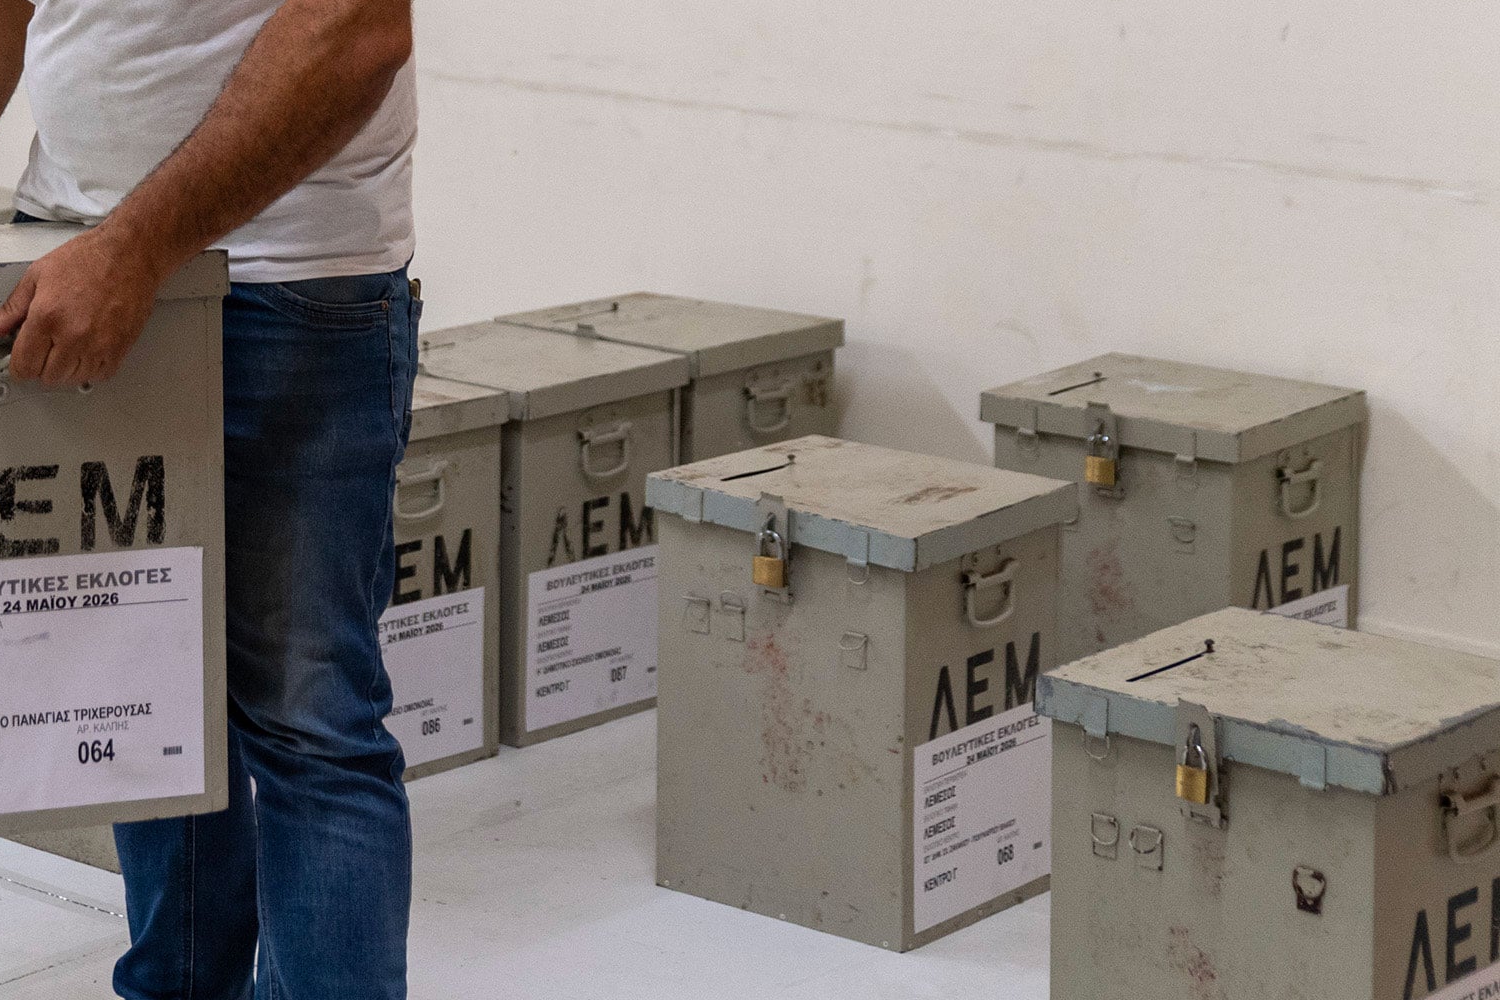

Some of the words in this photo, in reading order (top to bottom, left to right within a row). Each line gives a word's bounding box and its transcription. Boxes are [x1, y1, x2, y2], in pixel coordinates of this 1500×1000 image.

[547, 491, 655, 567] ΛΕΜ
[76, 568, 172, 590] ΕΚΛΟΓΕΣ
[393, 528, 472, 606] ΕΜ
[1252, 526, 1342, 610] ΛΕΜ
[3, 601, 21, 613] 24
[26, 595, 78, 612] ΜΑΪΟΥ
[83, 593, 120, 607] 2026
[378, 614, 420, 634] ΕΥΤΙΚΕΣ
[423, 603, 469, 622] ΕΚΛΟΓΕΣ
[929, 632, 1041, 741] ΛΕΜ
[12, 710, 70, 727] ΠΑΝΑΓΙΑΣ
[74, 703, 152, 721] ΤΡΙΧΕΡΟΥΣΑΣ
[94, 720, 129, 733] ΚΑΛΠΗΣ
[422, 718, 441, 736] 086
[78, 738, 115, 764] 064
[932, 730, 996, 766] ΒΟΥΛΕΥΤΙΚΕΣ
[998, 714, 1041, 739] ΕΚΛΟΓΕΣ
[1403, 876, 1500, 1000] ΛΕ
